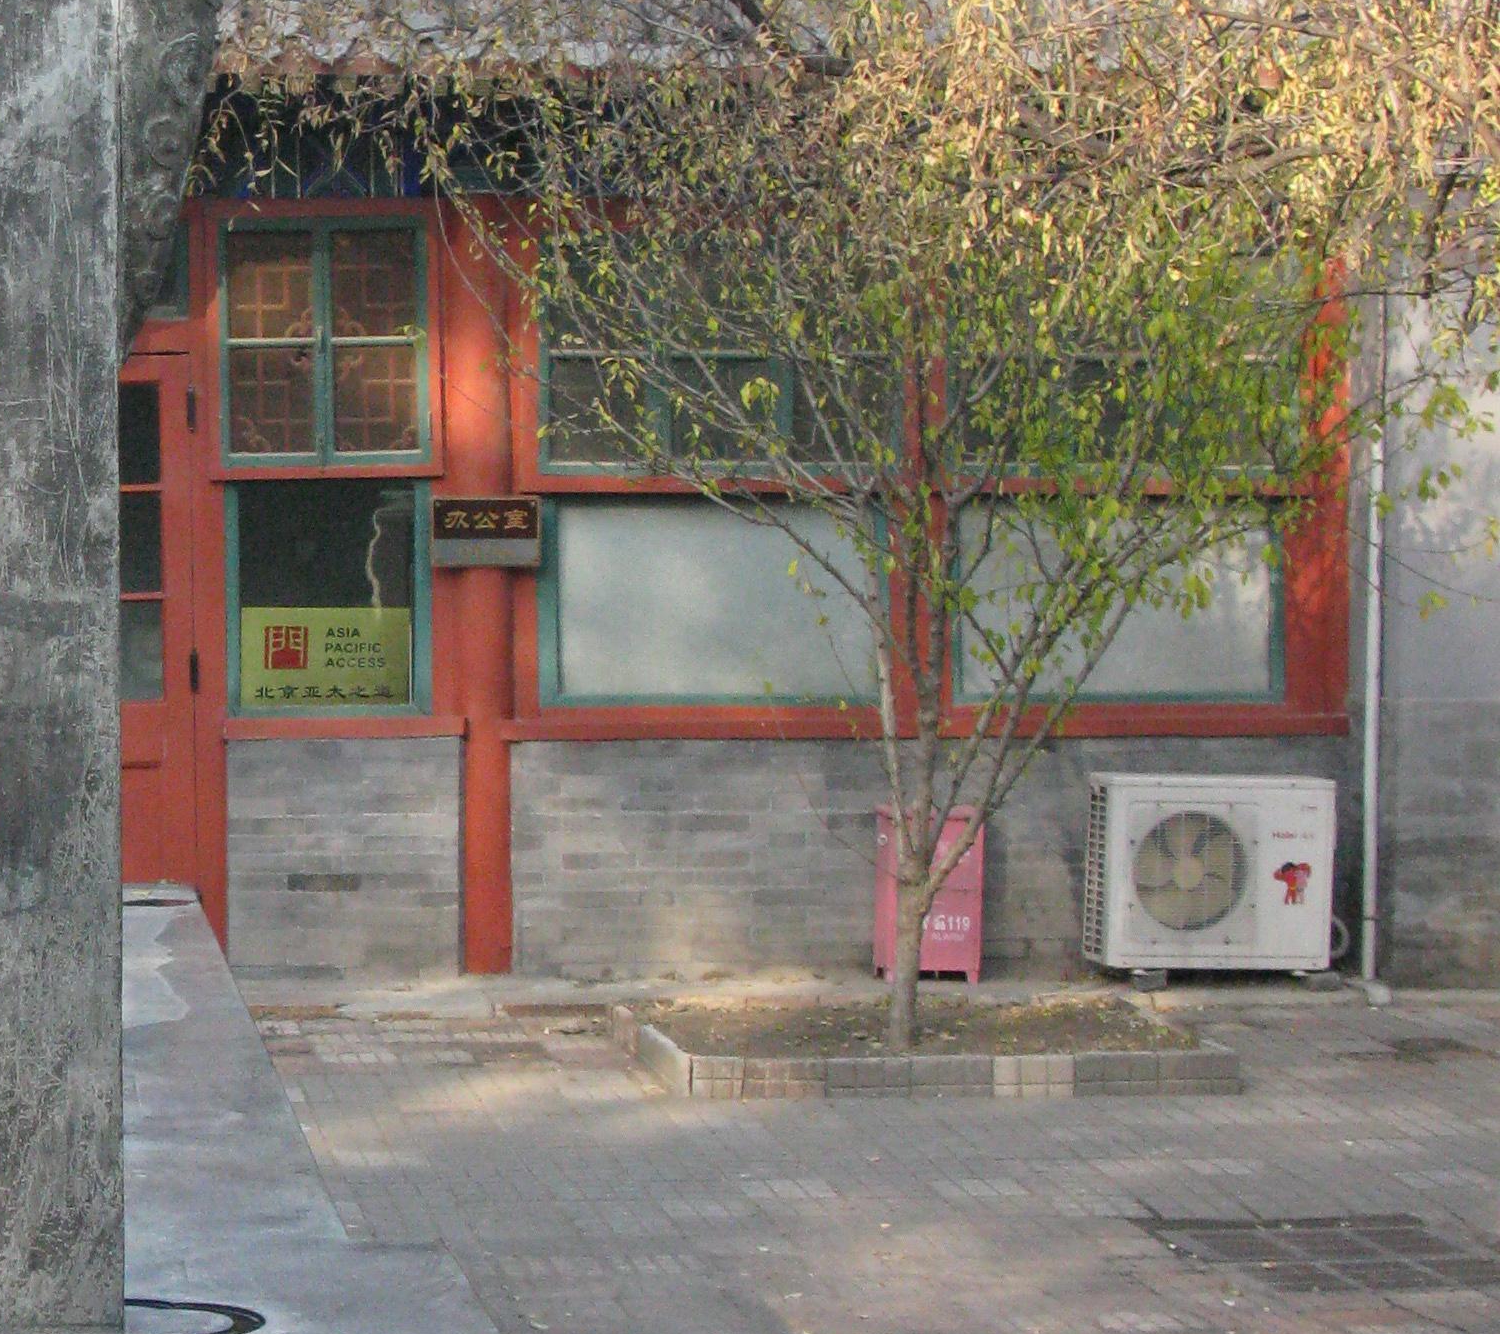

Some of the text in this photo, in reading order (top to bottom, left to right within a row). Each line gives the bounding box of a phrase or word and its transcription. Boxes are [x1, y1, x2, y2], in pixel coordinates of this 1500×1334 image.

[444, 509, 529, 529] 办公室
[325, 627, 361, 638] ASIA
[325, 642, 381, 653] PACIFIC
[325, 657, 386, 668] ACCESS
[948, 916, 969, 931] 119
